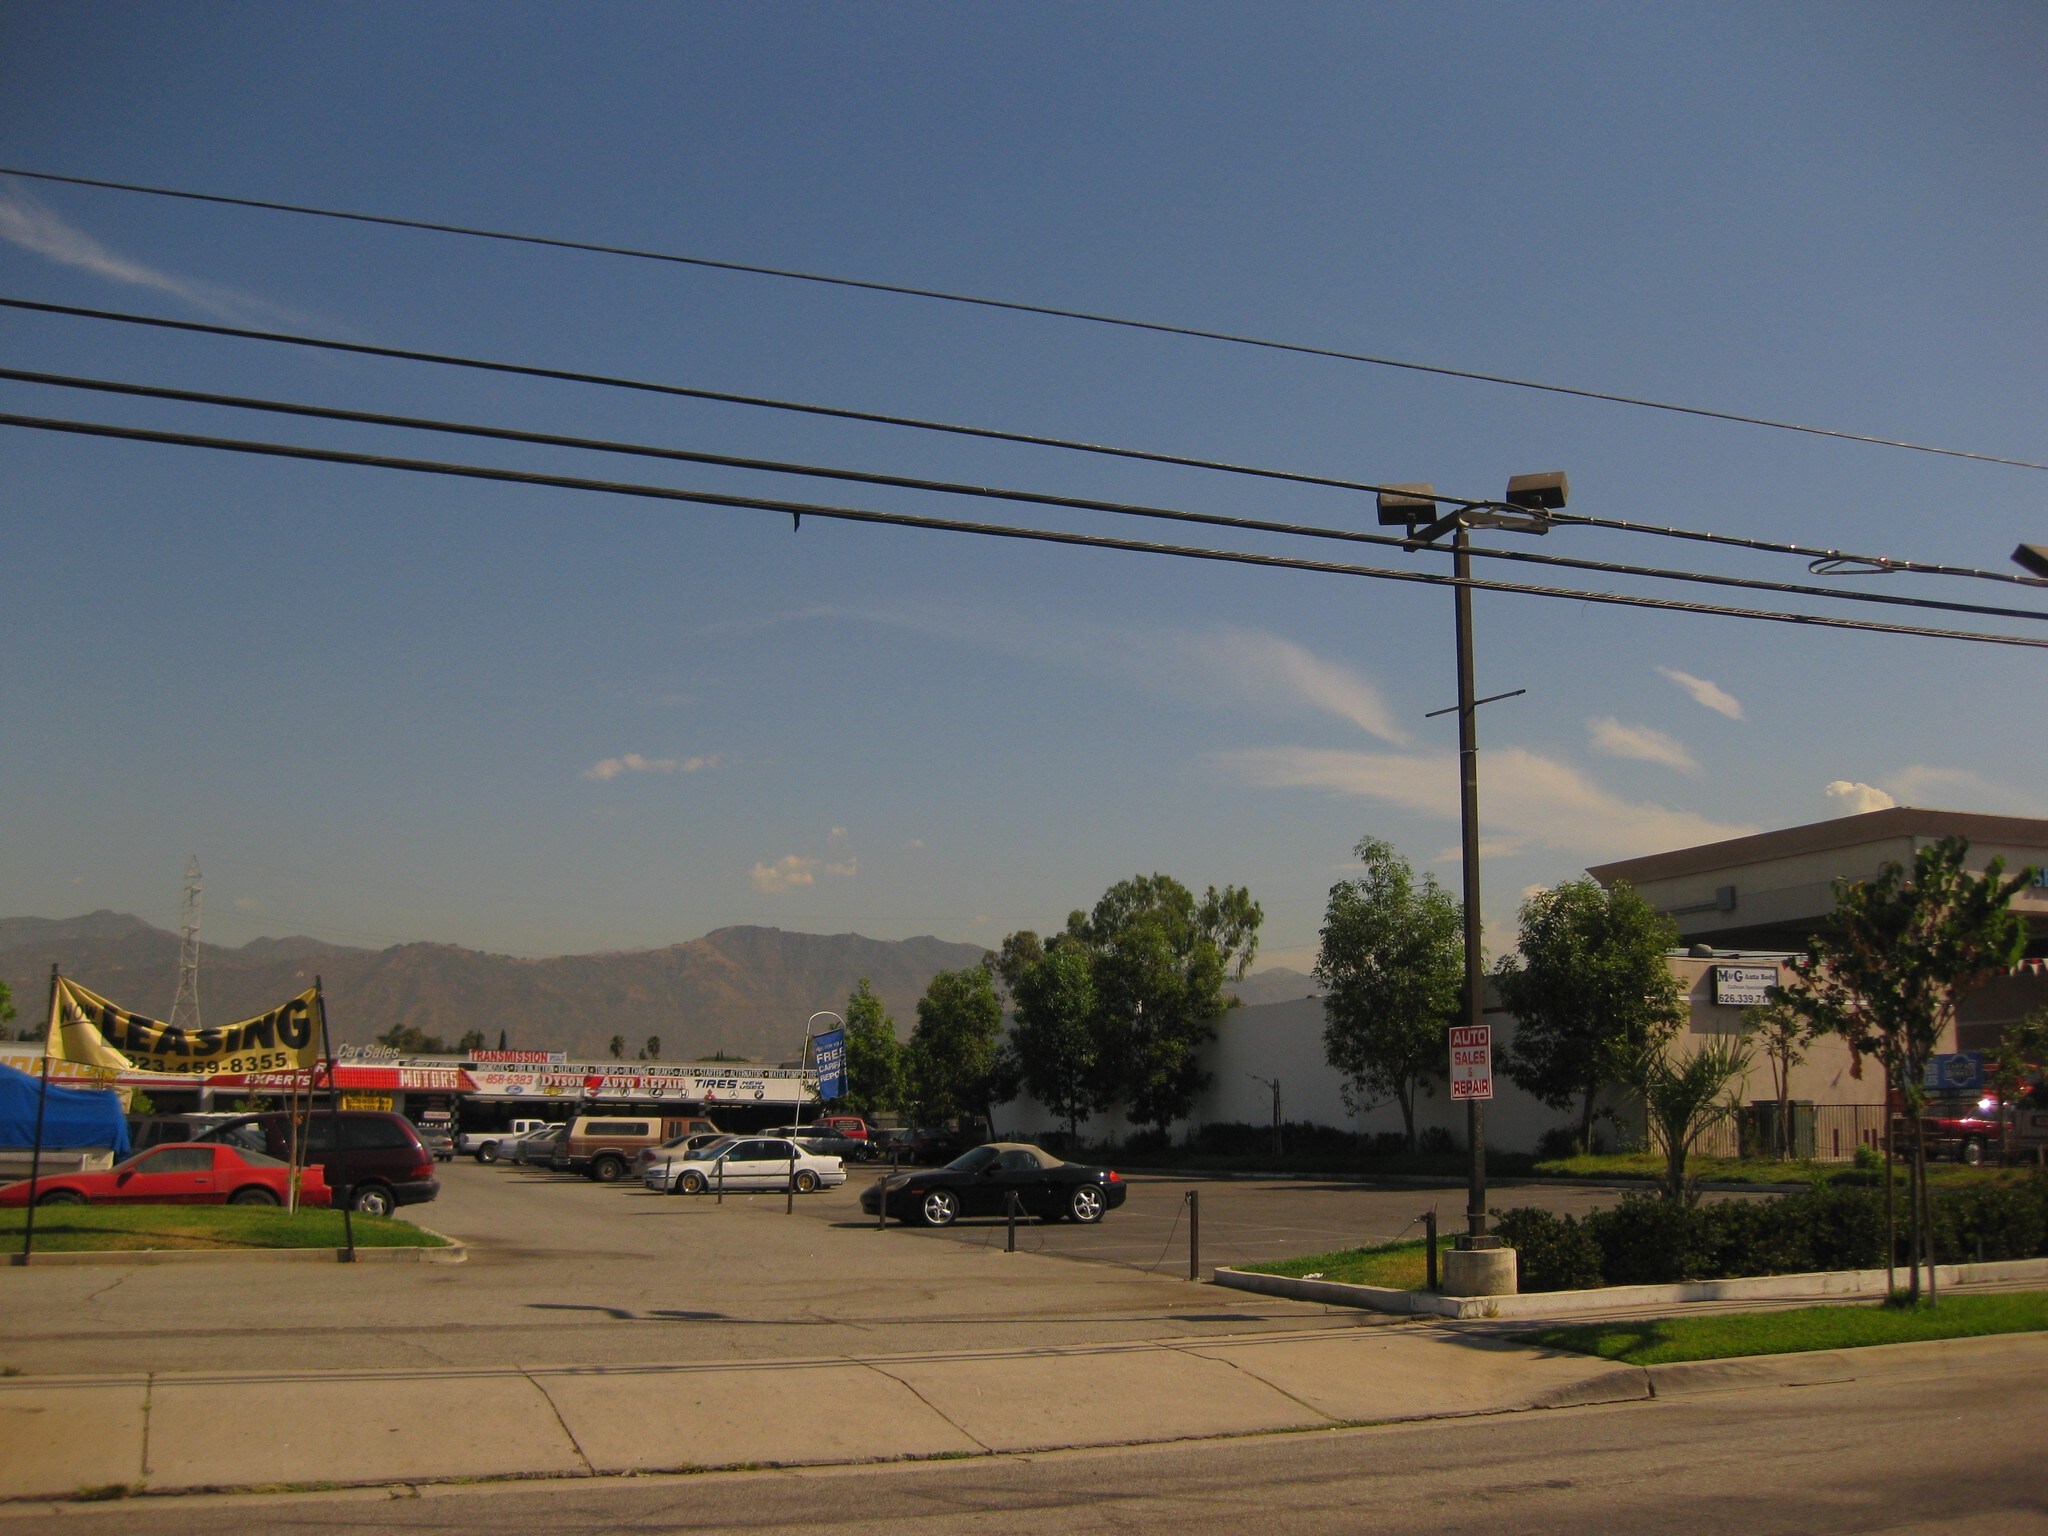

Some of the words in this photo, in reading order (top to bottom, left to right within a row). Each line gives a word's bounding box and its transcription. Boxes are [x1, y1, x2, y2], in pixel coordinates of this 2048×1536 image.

[1718, 970, 1743, 982] M&G
[1761, 974, 1777, 982] Body
[1719, 994, 1770, 1003] 626.339.71
[61, 1003, 97, 1021] NOW
[102, 998, 311, 1057] LEASING
[1453, 1029, 1487, 1045] AUTO
[339, 1043, 362, 1058] Car
[363, 1044, 401, 1059] Sales
[470, 1051, 548, 1063] TRANSMISSION
[1455, 1050, 1486, 1065] SALES
[400, 1069, 458, 1088] MOTORS
[729, 1070, 764, 1078] ALTERNATORS
[1467, 1067, 1473, 1077] &
[244, 1073, 312, 1085] EXPERTS
[485, 1074, 533, 1085] 858-6383
[541, 1074, 584, 1087] DYSON
[601, 1077, 635, 1088] AUTO
[639, 1078, 687, 1089] REPAIR
[695, 1079, 738, 1089] TIRES
[1453, 1079, 1488, 1095] REPAIR
